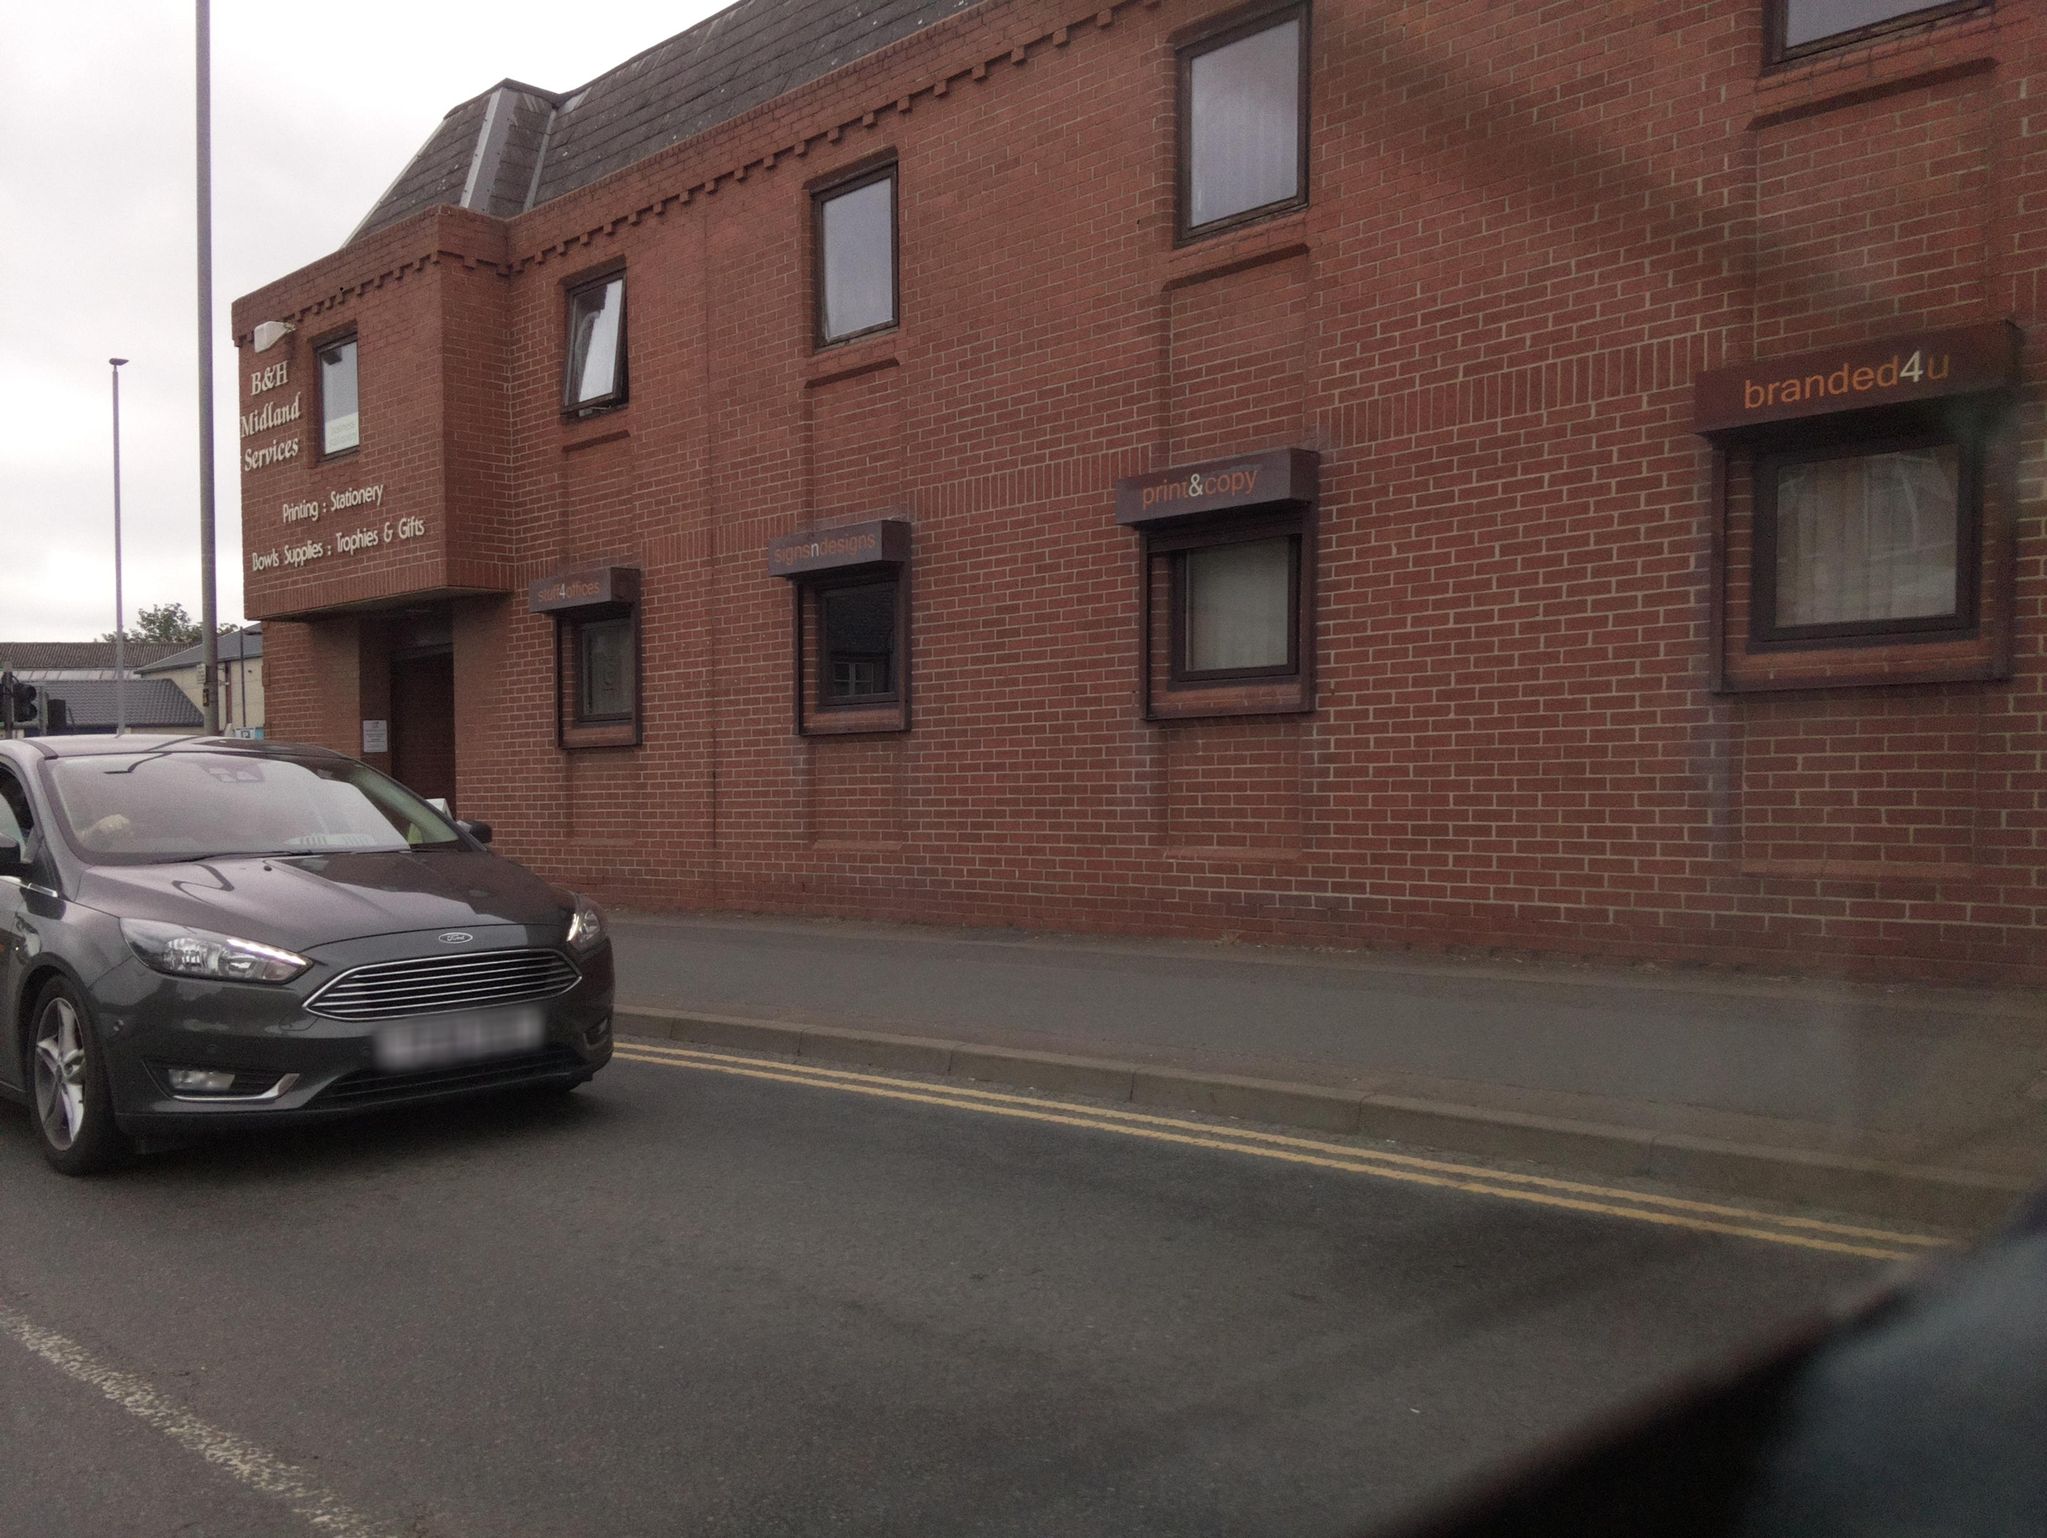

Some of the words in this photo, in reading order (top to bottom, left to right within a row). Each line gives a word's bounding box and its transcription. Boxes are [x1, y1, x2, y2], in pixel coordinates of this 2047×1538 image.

[251, 360, 288, 396] B&H
[1744, 350, 1950, 409] branded4u
[240, 391, 301, 438] Midland
[245, 438, 299, 472] Services
[282, 499, 319, 523] Printing
[330, 484, 384, 511] Stationery
[1142, 469, 1258, 510] print&copy
[252, 549, 279, 572] Bowls
[284, 540, 323, 568] Supplies
[336, 528, 379, 556] Trophies
[383, 522, 393, 543] &
[399, 516, 425, 540] Gifts
